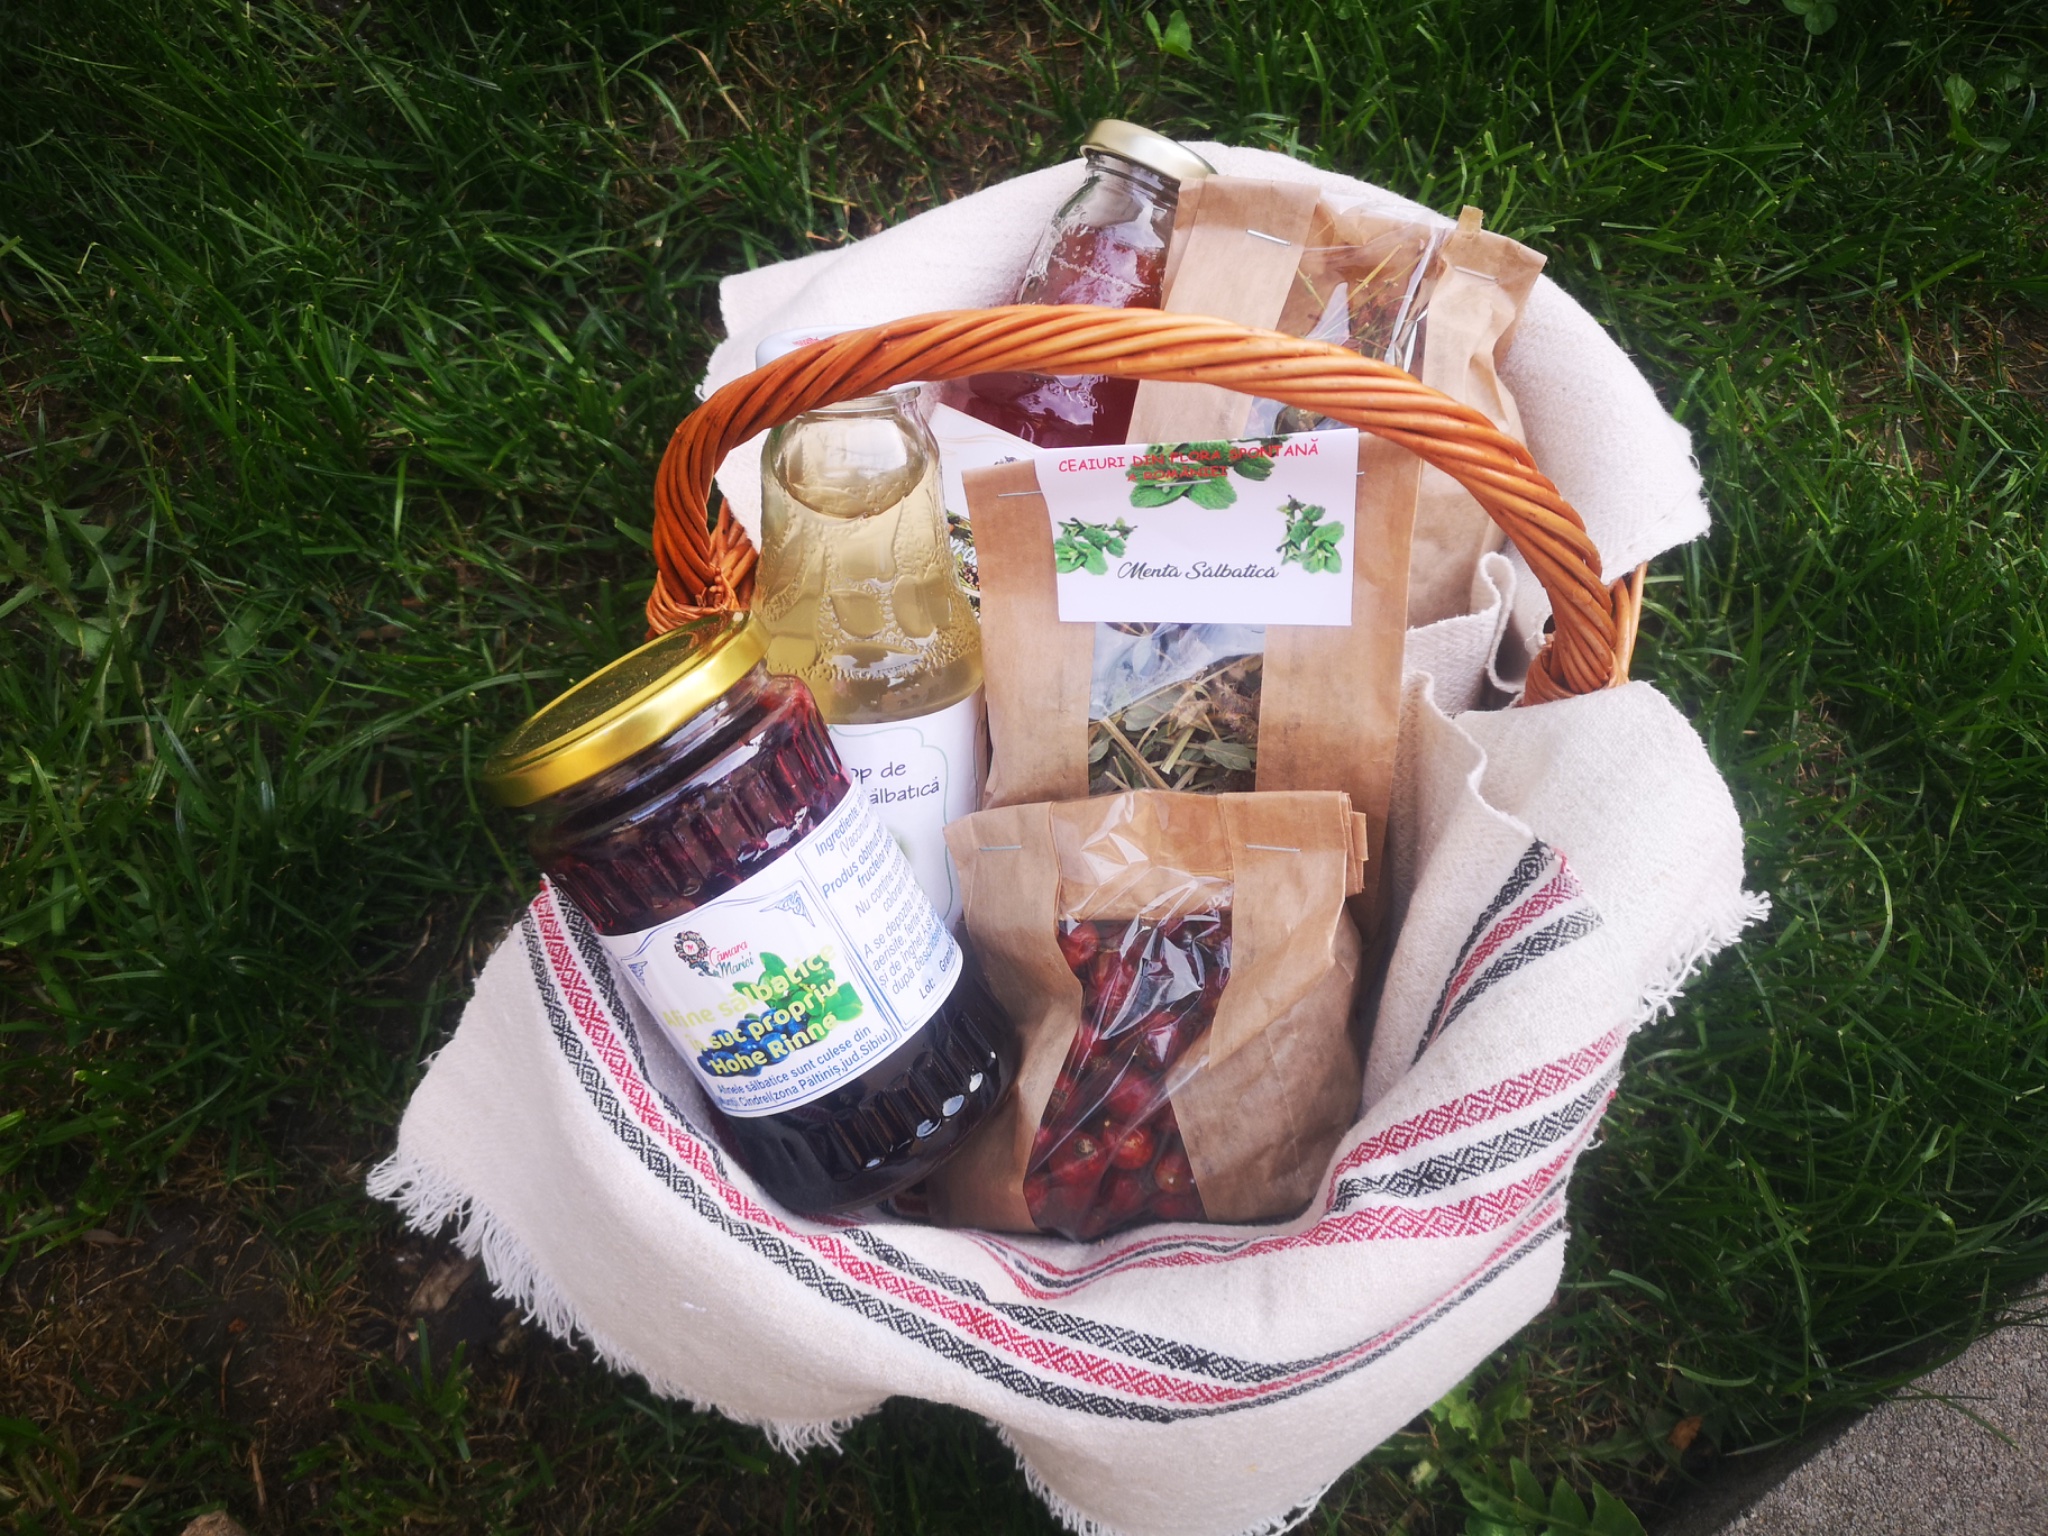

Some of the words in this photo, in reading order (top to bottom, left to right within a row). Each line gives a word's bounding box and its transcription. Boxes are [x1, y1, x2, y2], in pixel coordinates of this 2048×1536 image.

[1058, 456, 1126, 472] CEAIURI
[1133, 453, 1165, 467] DIN
[1169, 449, 1221, 465] FLORA
[1228, 438, 1319, 460] SPONTANĂ
[880, 761, 907, 779] de
[869, 776, 940, 804] ălbatică
[821, 861, 859, 899] Produs
[855, 899, 871, 918] Nu
[863, 943, 874, 960] A
[873, 933, 886, 950] se
[717, 944, 838, 1018] sălbatice
[889, 959, 902, 977] de
[892, 965, 916, 995] după
[919, 977, 936, 1000] Lot:
[708, 1029, 749, 1051] suc
[747, 978, 840, 1041] propriu
[708, 1050, 768, 1076] Hohe
[766, 1013, 839, 1059] Rinne
[744, 1072, 790, 1092] sălbatice
[790, 1059, 818, 1078] sunt
[818, 1040, 852, 1066] culese
[853, 1025, 872, 1043] din
